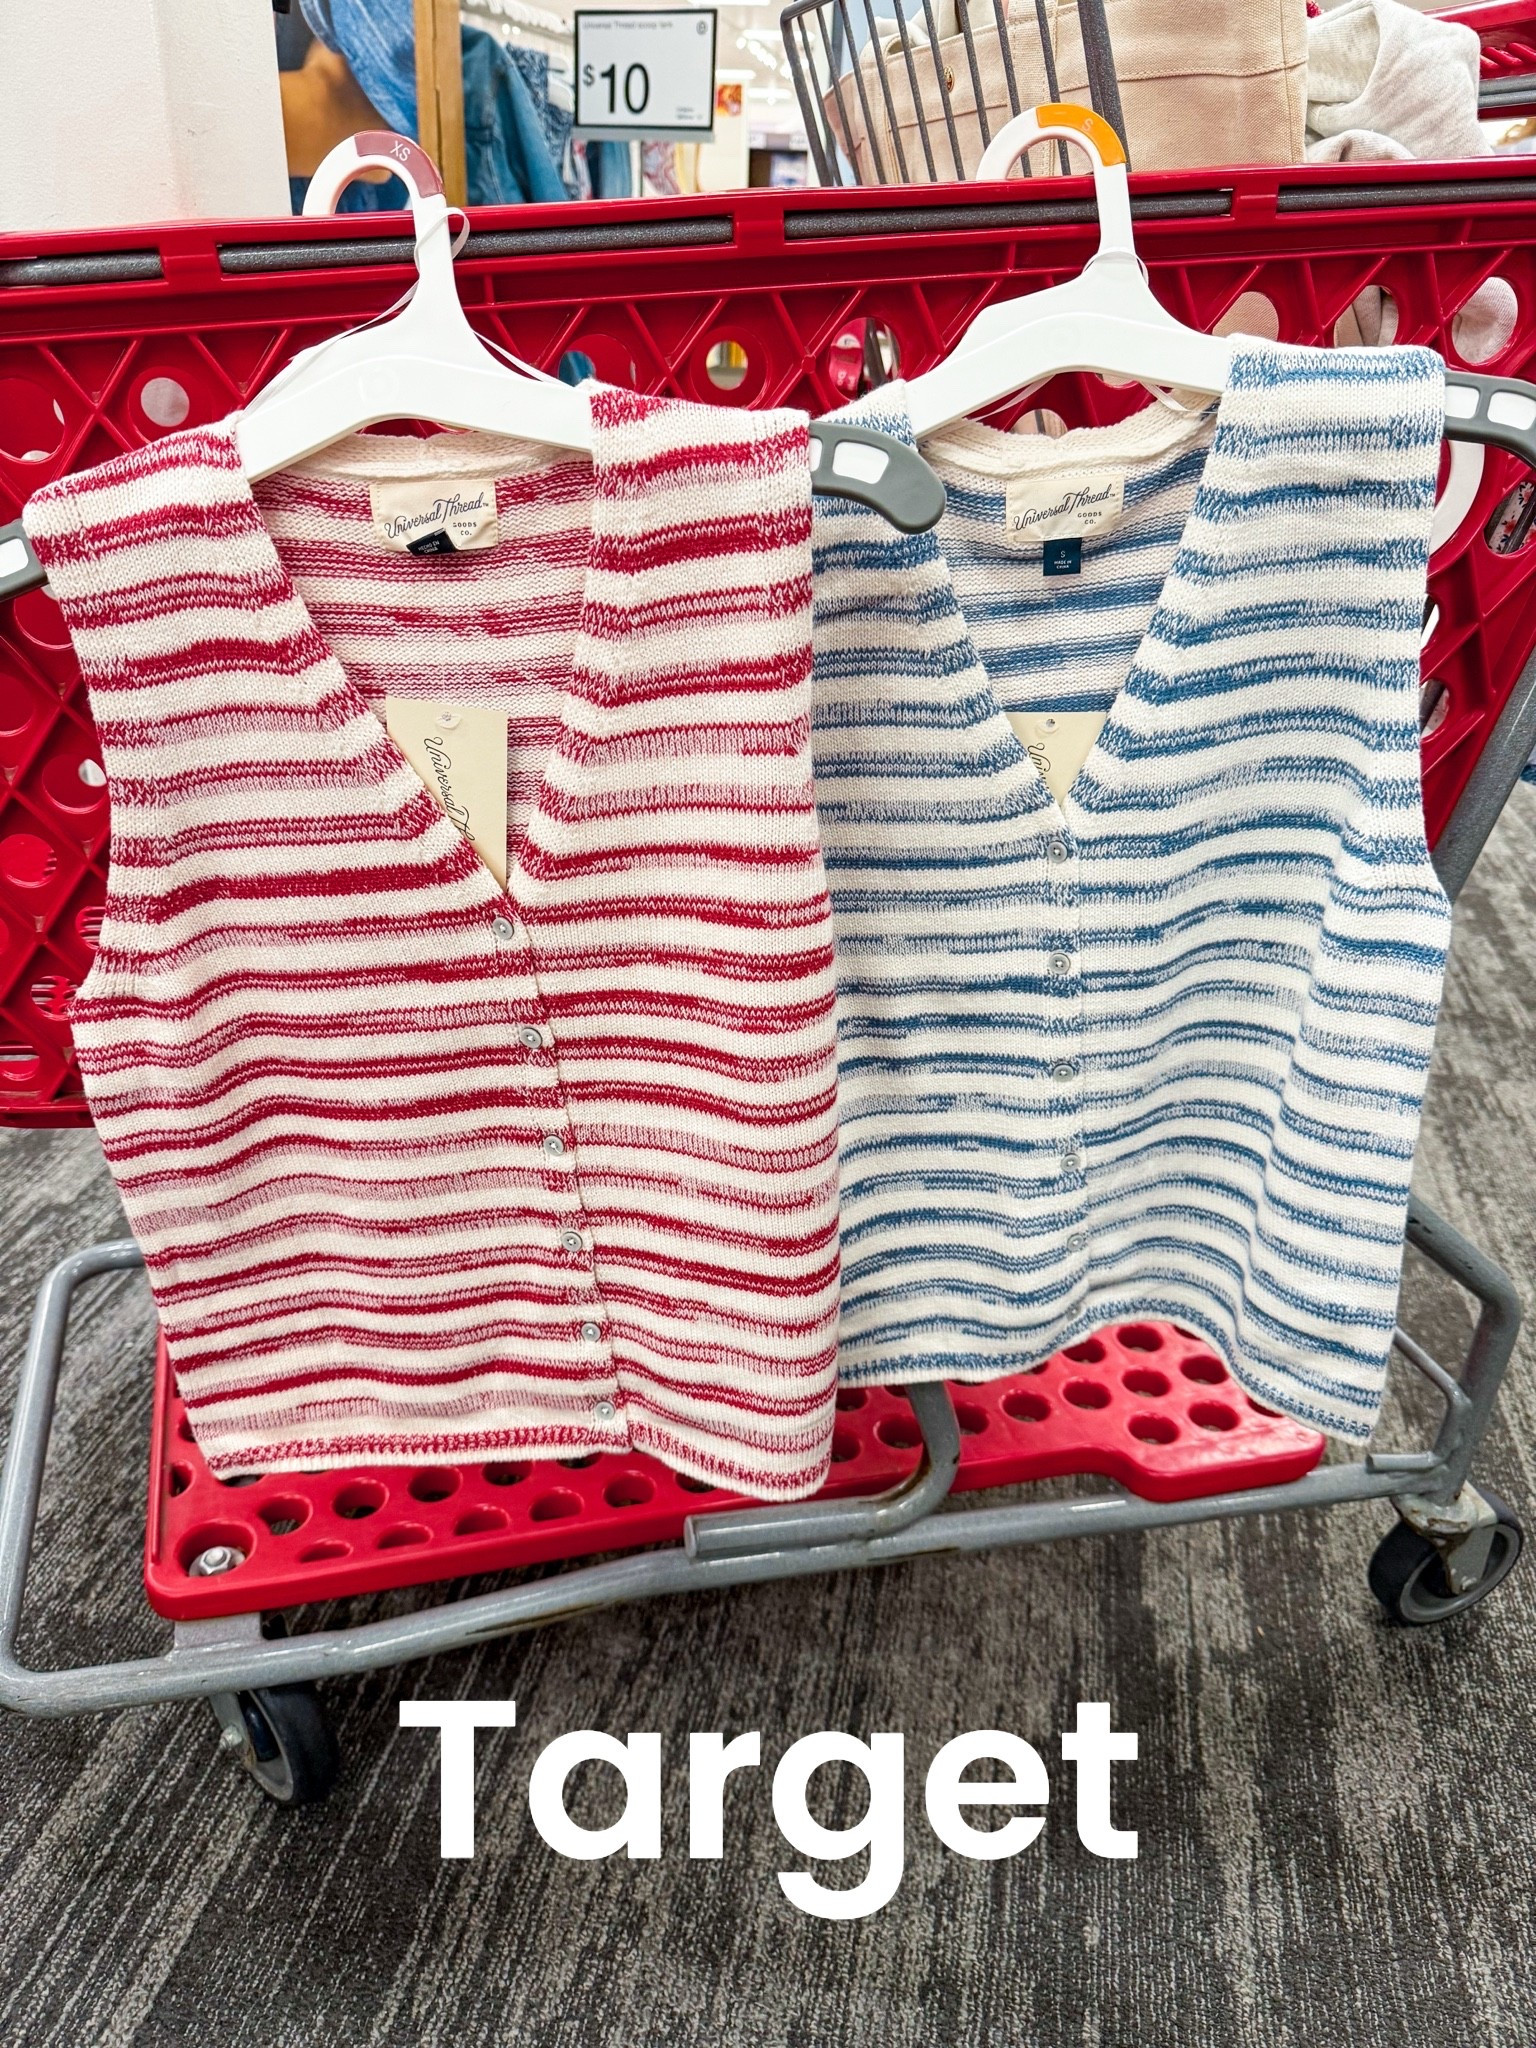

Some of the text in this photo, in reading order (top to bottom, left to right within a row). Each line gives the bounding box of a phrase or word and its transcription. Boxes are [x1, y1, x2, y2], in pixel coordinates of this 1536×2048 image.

[1082, 118, 1094, 132] S
[390, 140, 410, 162] XS
[384, 501, 442, 538] Universal
[1014, 495, 1071, 530] Universal
[1060, 550, 1066, 558] S
[423, 736, 466, 818] Universal
